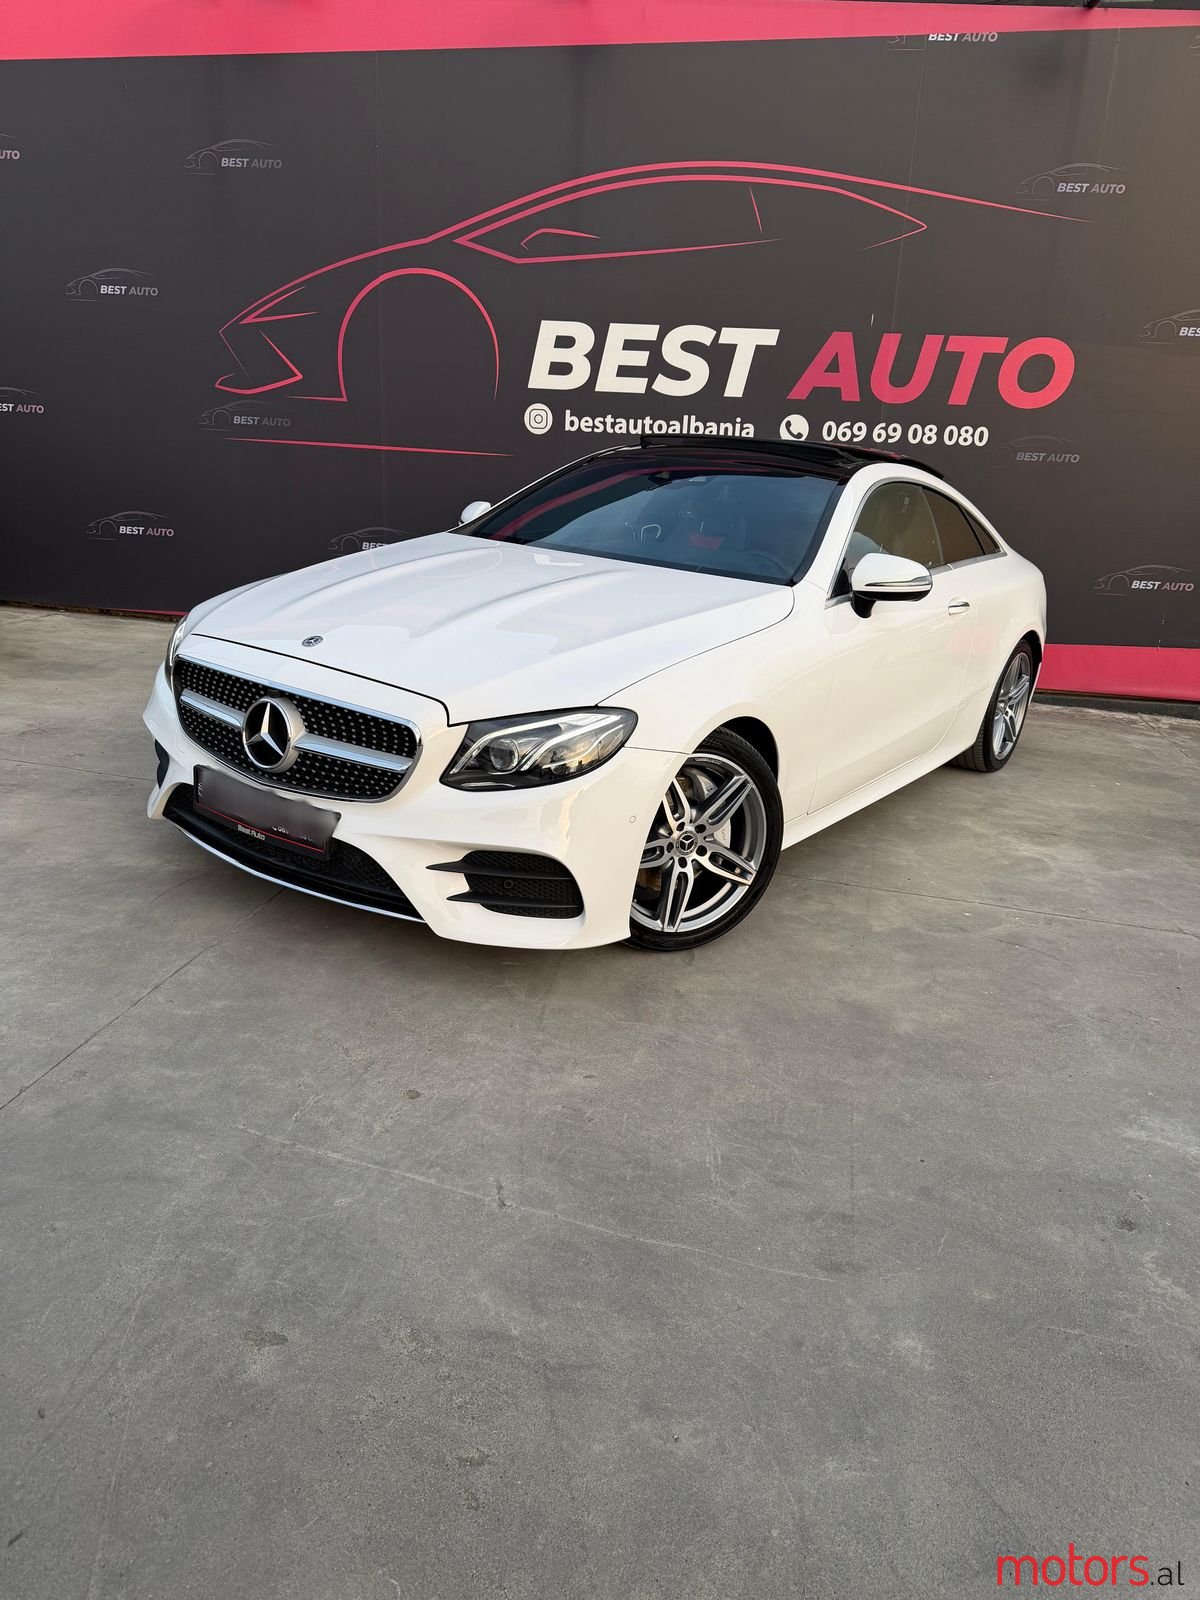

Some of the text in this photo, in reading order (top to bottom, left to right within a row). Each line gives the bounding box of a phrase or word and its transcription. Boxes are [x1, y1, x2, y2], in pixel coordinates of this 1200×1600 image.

[961, 32, 998, 42] AUTO
[0, 149, 20, 160] UTO
[221, 157, 282, 169] BEST AUTO
[1056, 182, 1126, 194] BEST AUTO
[100, 285, 159, 297] BEST AUTO
[1178, 326, 1200, 337] BES
[527, 320, 1075, 409] BEST AUTO
[15, 404, 45, 414] AUTO
[233, 415, 291, 427] BEST AUTO
[564, 410, 755, 438] bestautoalbania
[822, 420, 989, 447] 069 69 08 080
[1015, 451, 1080, 463] BEST AUTO
[119, 525, 175, 537] BEST AUTO
[362, 541, 386, 550] BES
[1130, 580, 1195, 592] BEST AUTO
